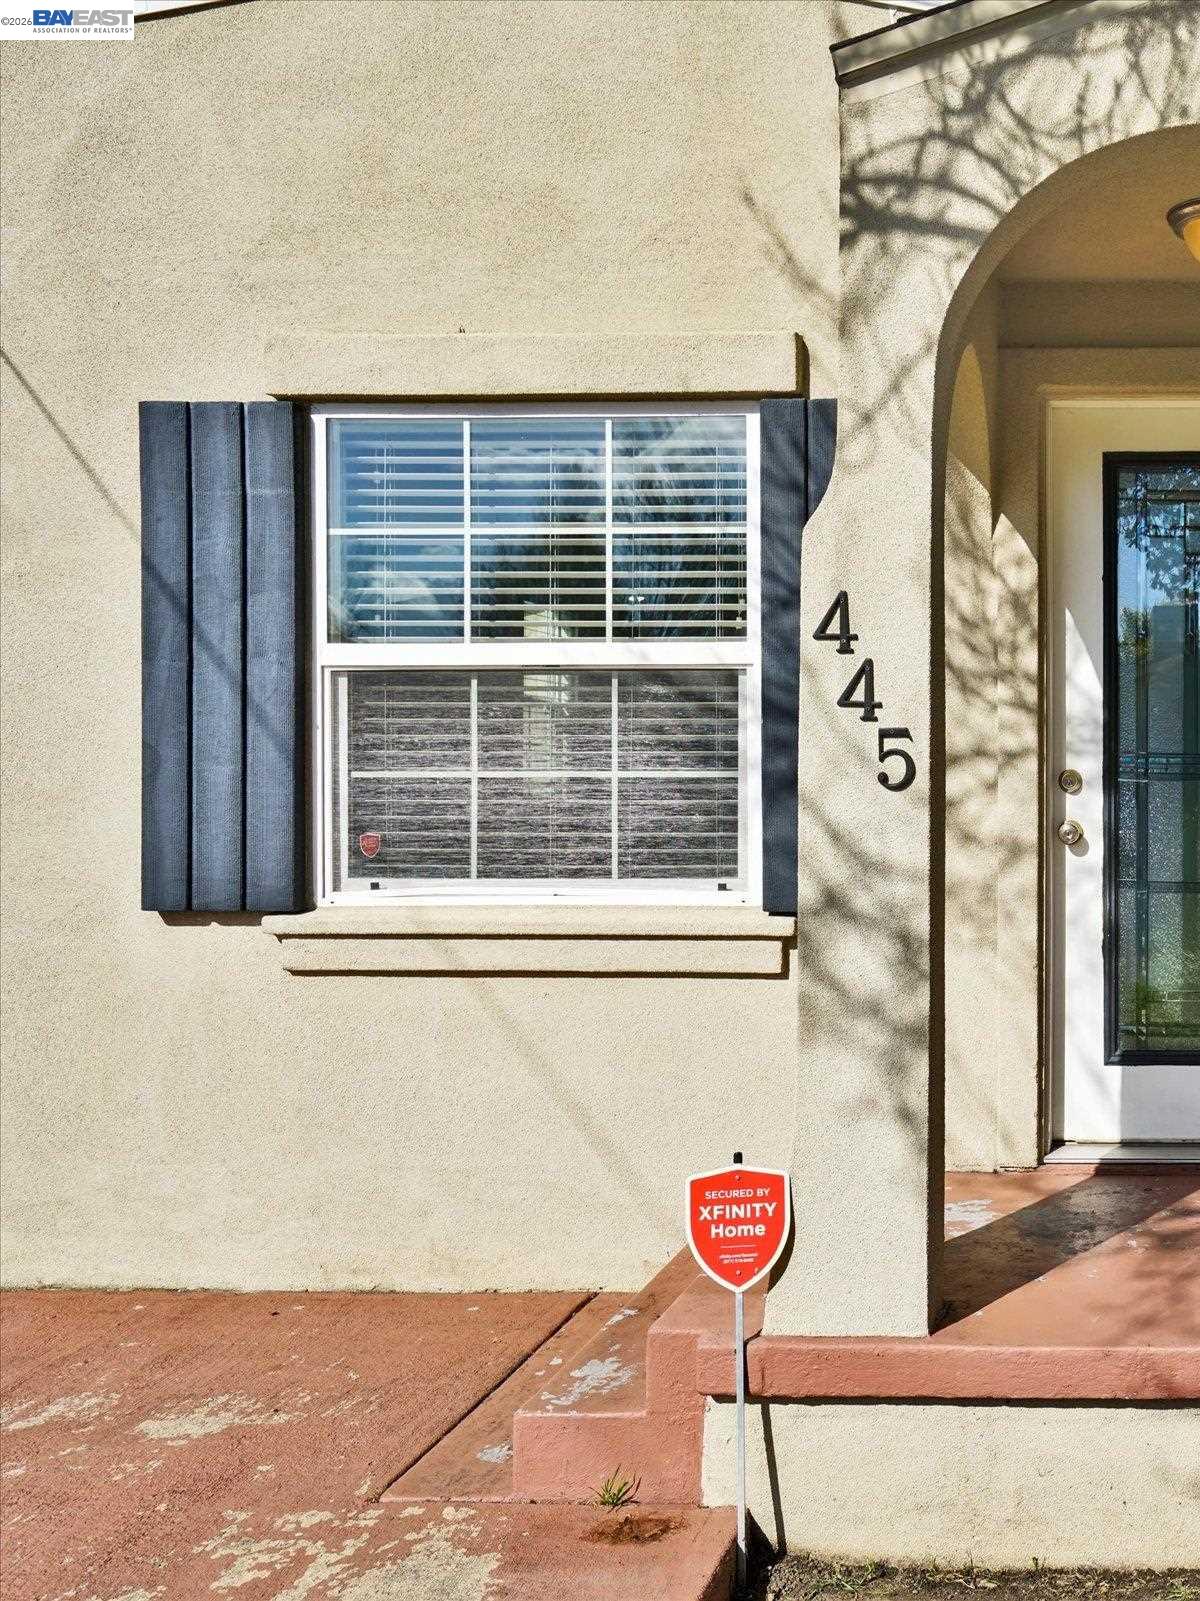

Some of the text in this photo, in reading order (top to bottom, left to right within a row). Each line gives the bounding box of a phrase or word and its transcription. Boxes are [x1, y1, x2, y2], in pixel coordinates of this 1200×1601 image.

[704, 1187, 770, 1200] SECURED BY
[699, 1201, 777, 1221] XFINITY
[710, 1223, 766, 1239] Home
